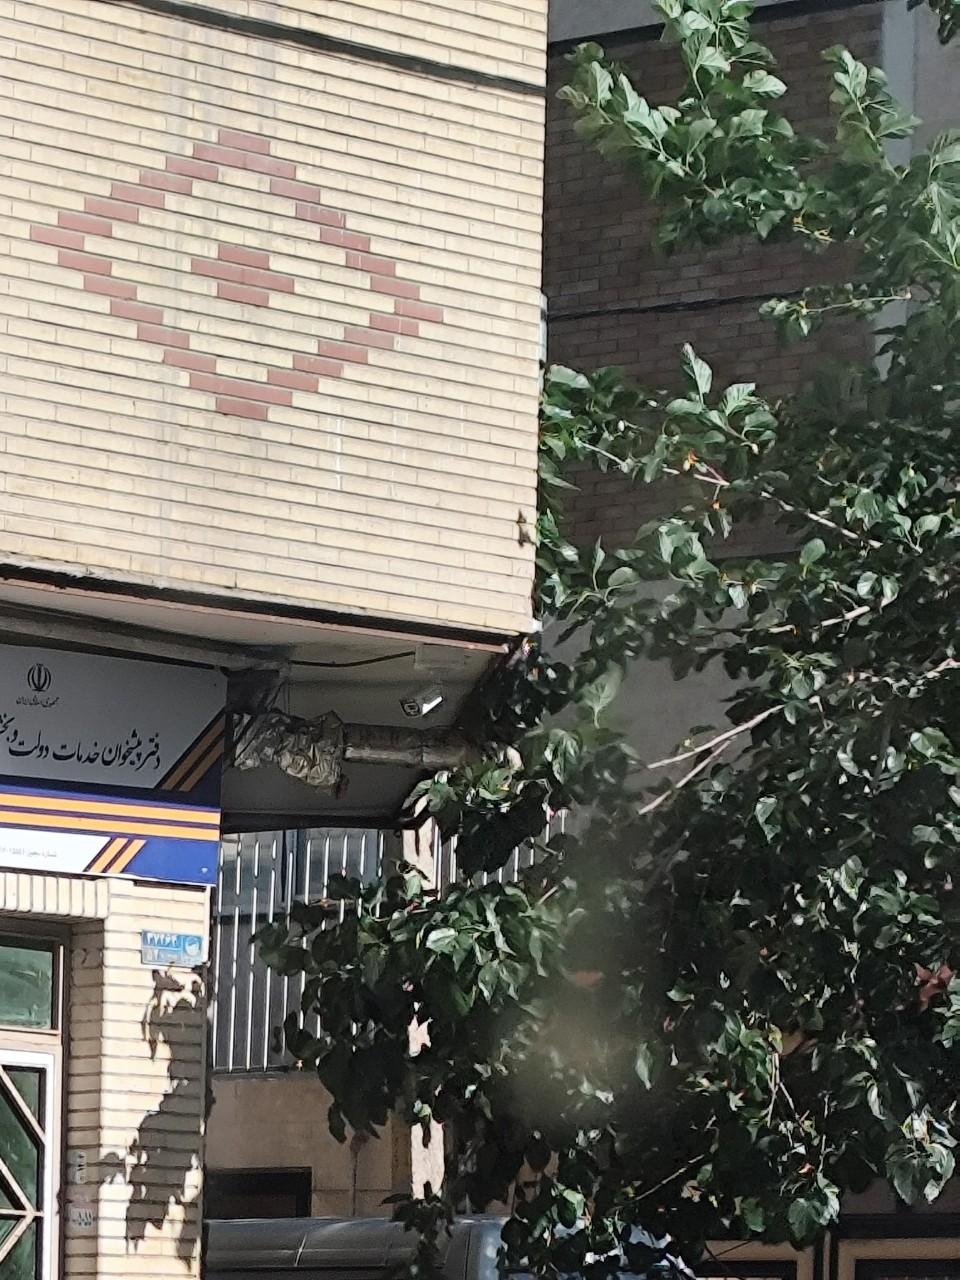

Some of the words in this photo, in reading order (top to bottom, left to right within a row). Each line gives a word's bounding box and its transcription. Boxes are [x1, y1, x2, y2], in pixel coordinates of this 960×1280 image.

[8, 729, 49, 759] دولت
[52, 741, 100, 764] خدمات
[101, 728, 143, 766] پیشخوان
[135, 732, 161, 771] دفتر
